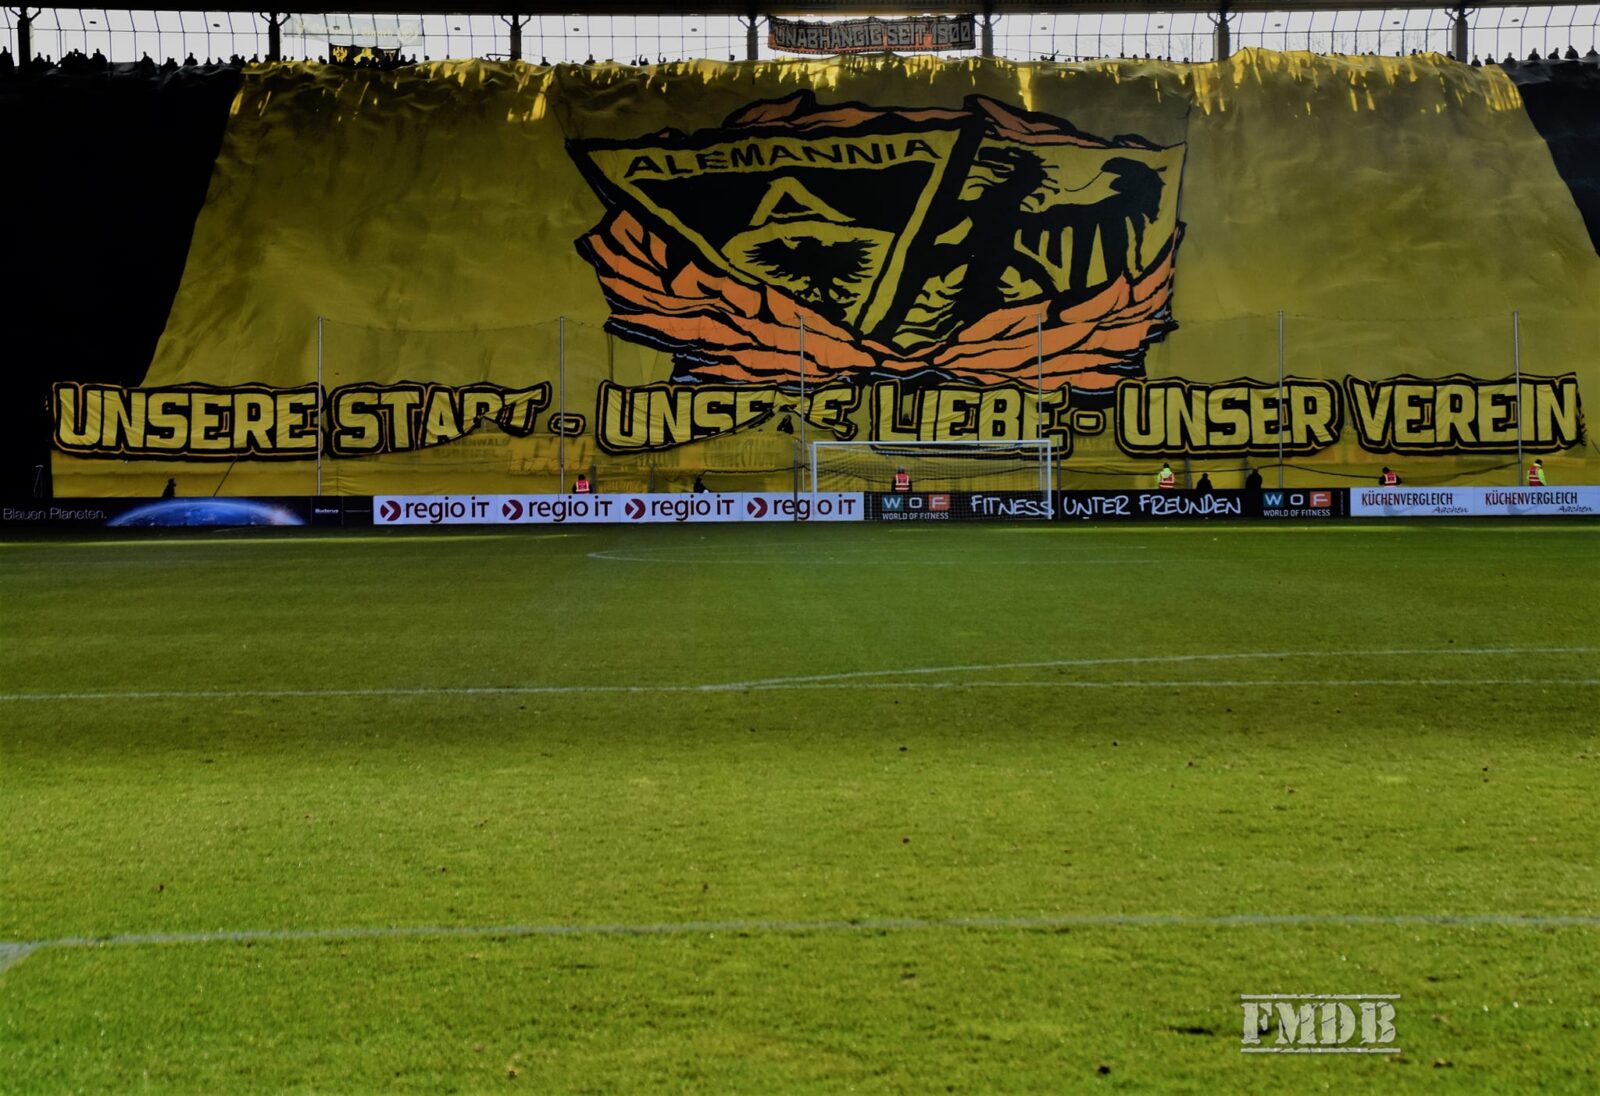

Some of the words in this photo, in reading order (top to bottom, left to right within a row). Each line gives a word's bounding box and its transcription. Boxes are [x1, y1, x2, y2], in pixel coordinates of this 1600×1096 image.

[887, 24, 927, 46] SEIT
[623, 139, 943, 179] ALEMANNIA
[57, 386, 317, 451] UNSERE
[604, 386, 853, 447] UNSEE
[878, 383, 1066, 448] LIEBE
[1122, 386, 1334, 447] UNSER
[1353, 382, 1577, 445] VEREIN
[529, 495, 588, 522] regio
[651, 494, 711, 521] regio
[773, 493, 832, 520] rego
[970, 494, 1055, 516] FITNESS
[1063, 495, 1131, 515] UNTER
[1138, 493, 1242, 515] FREUNDEN
[1361, 490, 1453, 506] KÜCHENVERGLEICH
[1485, 490, 1578, 506] KÜCHENVERGLEICH
[3, 507, 46, 520] Blauen
[50, 507, 107, 520] Planeten.
[405, 497, 466, 523] regio
[882, 512, 907, 520] WORLD
[920, 512, 949, 520] FITNESS
[1263, 509, 1289, 517] WORLD
[1302, 509, 1331, 517] FITNESS
[1431, 506, 1469, 514] Aachen
[1556, 505, 1593, 514] Aachen
